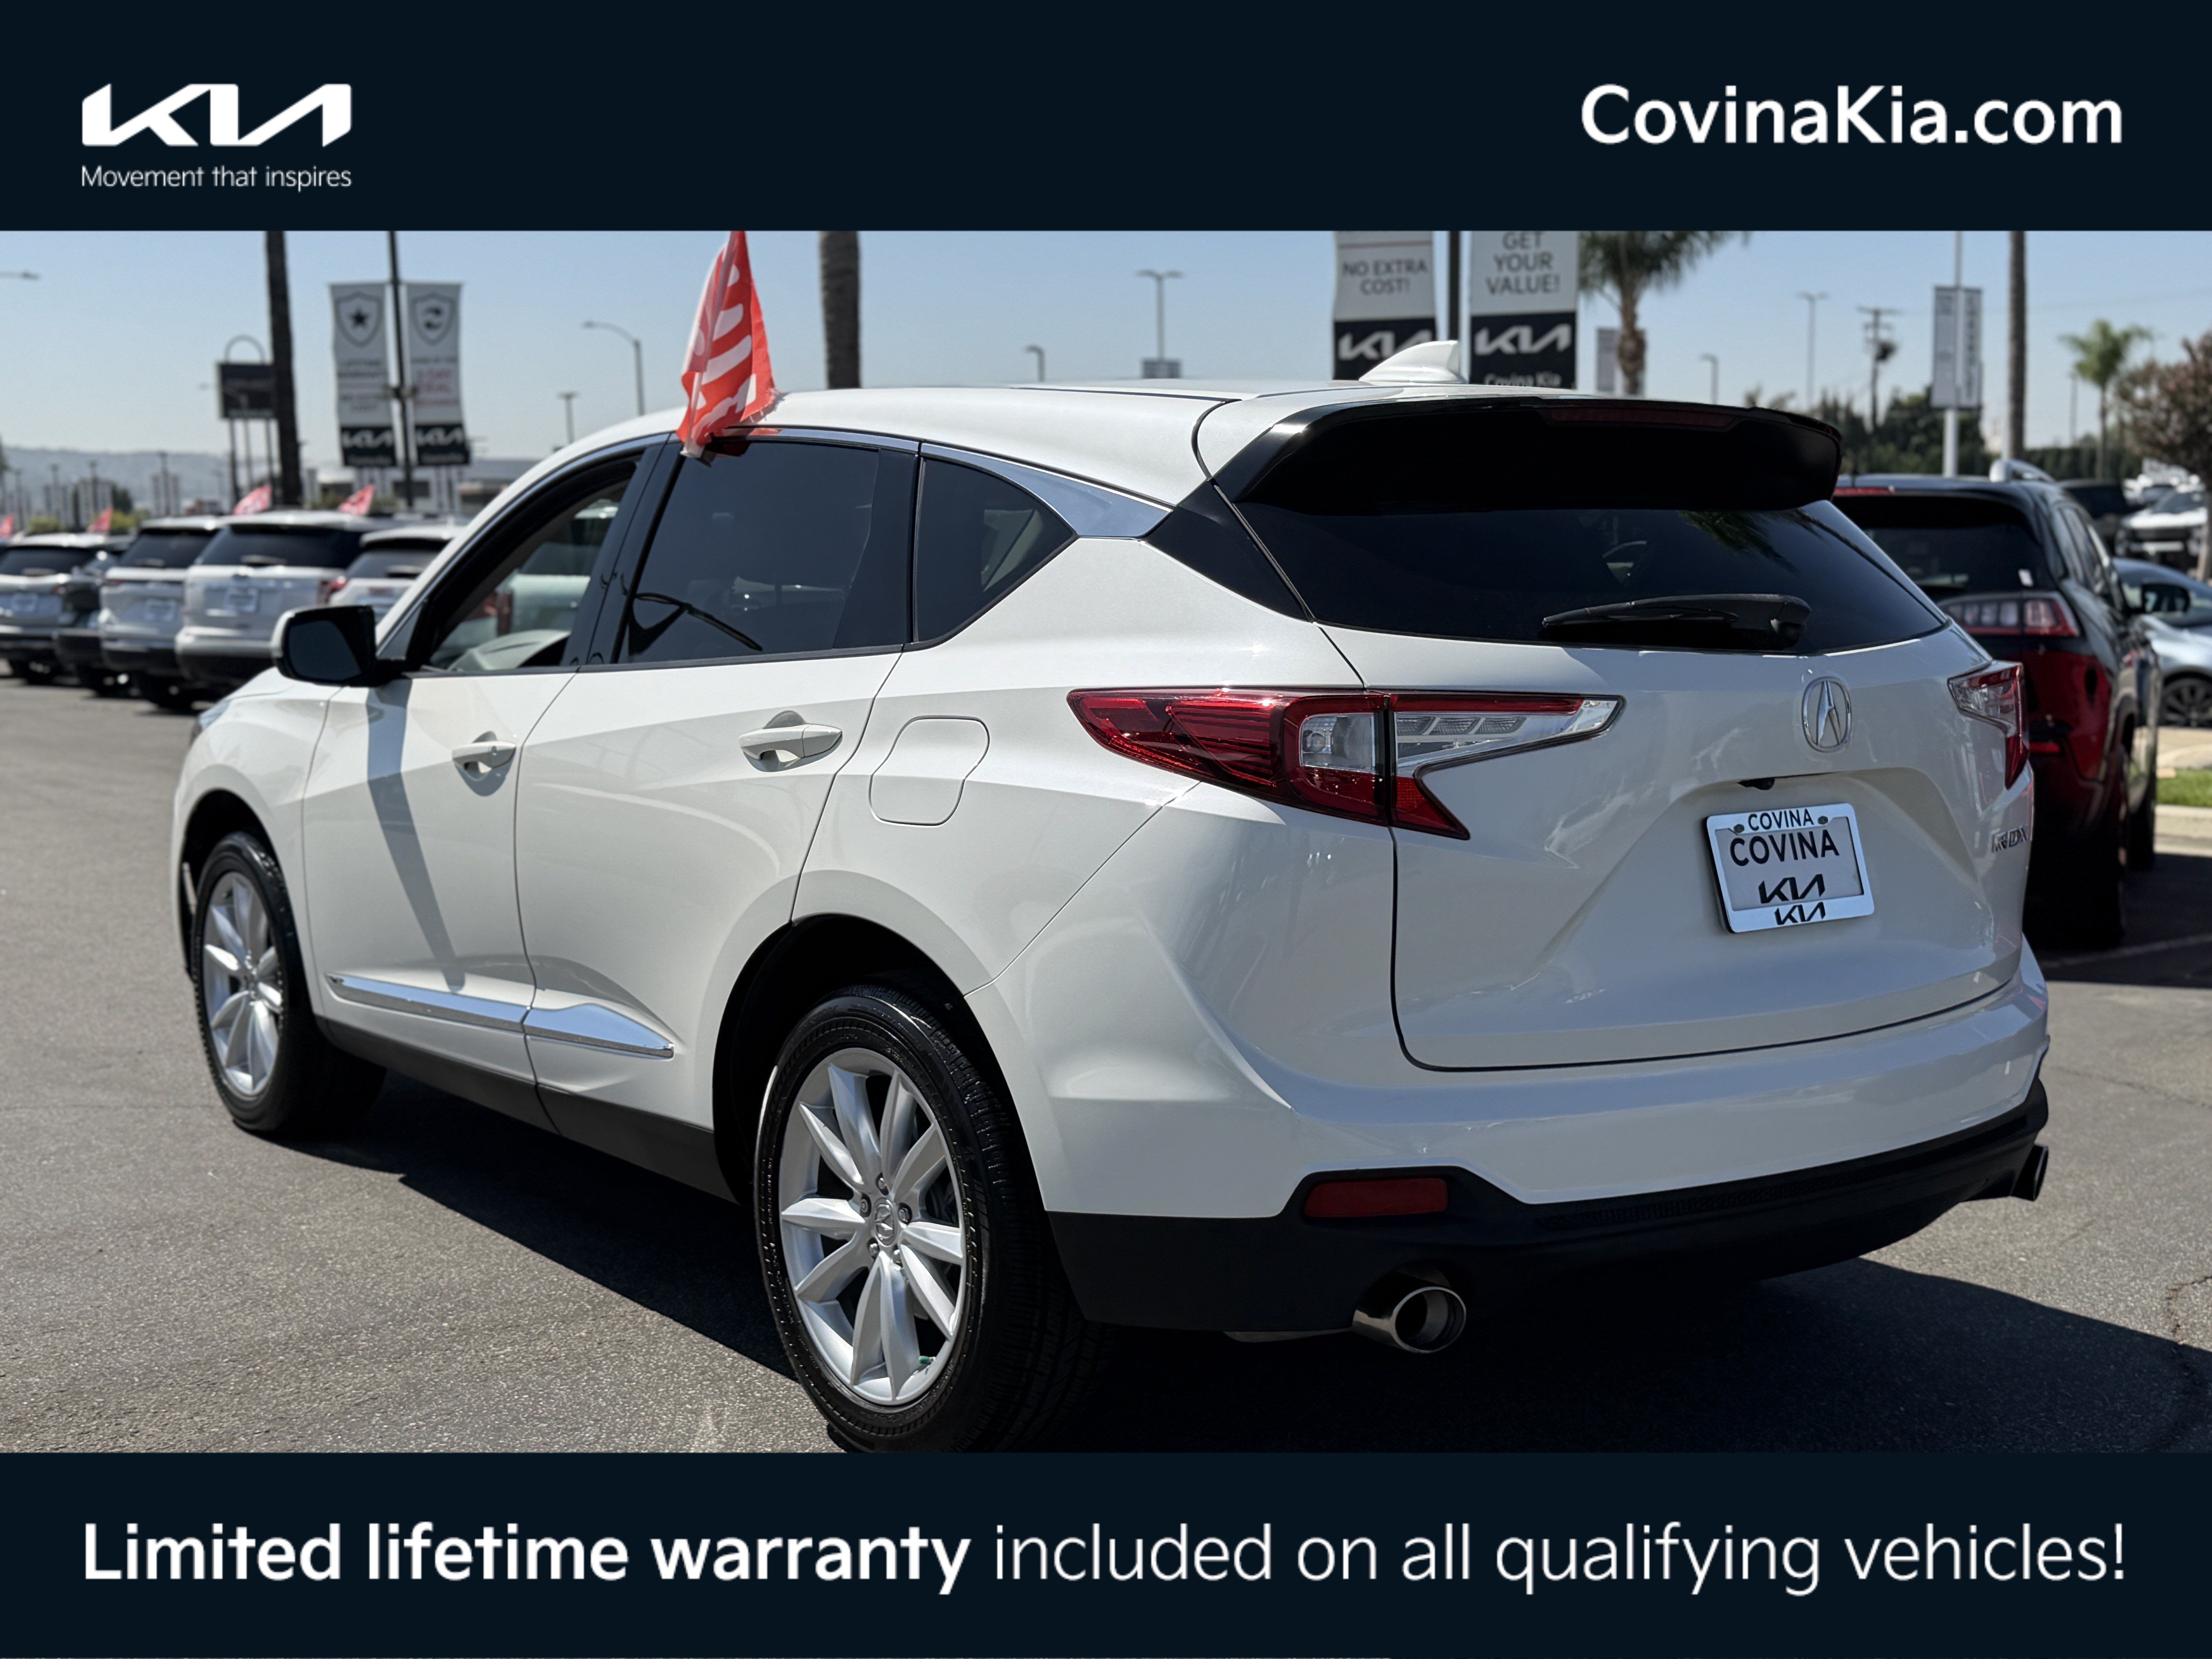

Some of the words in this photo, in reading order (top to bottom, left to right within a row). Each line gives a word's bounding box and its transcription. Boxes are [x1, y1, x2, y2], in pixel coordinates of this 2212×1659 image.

[1502, 231, 1544, 250] GET
[1342, 260, 1369, 277] NO
[1373, 258, 1428, 275] EXTRA
[1493, 251, 1554, 272] YOUR
[1360, 277, 1411, 296] COST!
[1486, 273, 1561, 295] VALUE!
[1474, 324, 1572, 356] KIA
[1748, 809, 1814, 831] COVINA
[1729, 829, 1840, 866] COVINA
[1758, 874, 1826, 904] KIA
[1774, 902, 1826, 926] KIA
